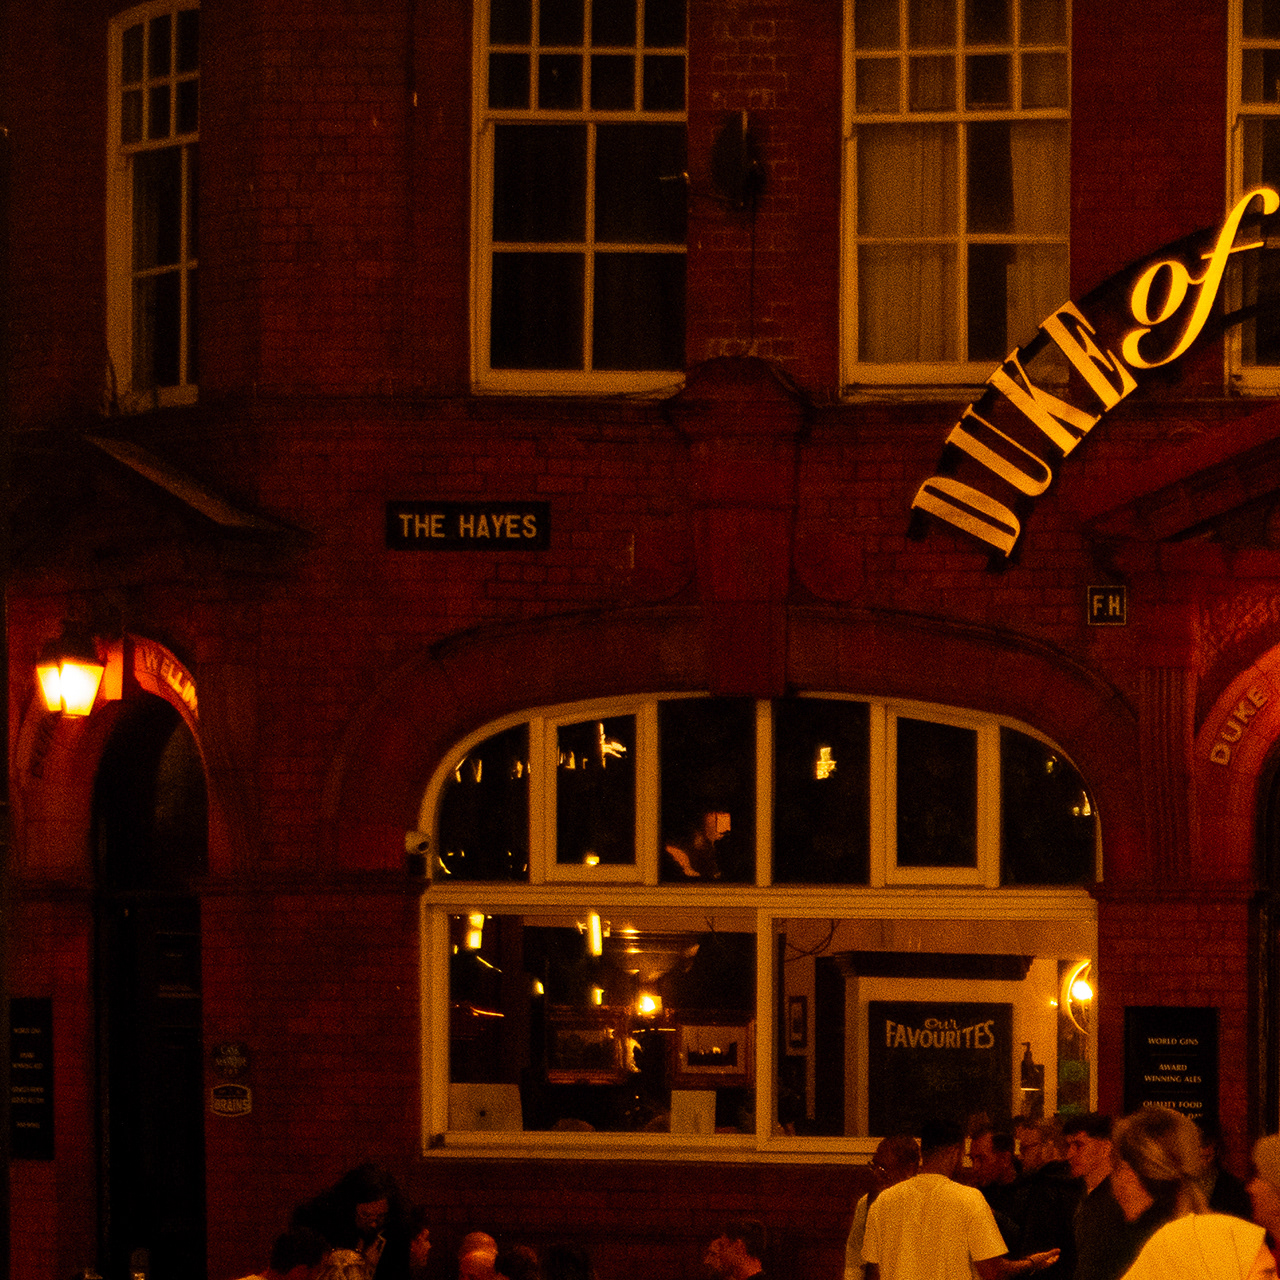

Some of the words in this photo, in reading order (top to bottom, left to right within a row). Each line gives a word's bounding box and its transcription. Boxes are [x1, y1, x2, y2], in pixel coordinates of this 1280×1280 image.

[910, 299, 1138, 558] DUKE
[1121, 187, 1280, 369] of
[398, 513, 446, 539] THE
[458, 513, 537, 539] HAYES
[1210, 685, 1270, 767] DUKE
[885, 1018, 996, 1050] FAVOURITES
[1147, 1037, 1178, 1046] WORLD
[1179, 1037, 1199, 1046] GINS
[1158, 1063, 1188, 1072] AWARD
[1144, 1074, 1182, 1083] WINNING
[1184, 1075, 1202, 1084] ALES
[1178, 1101, 1203, 1109] FOOD
